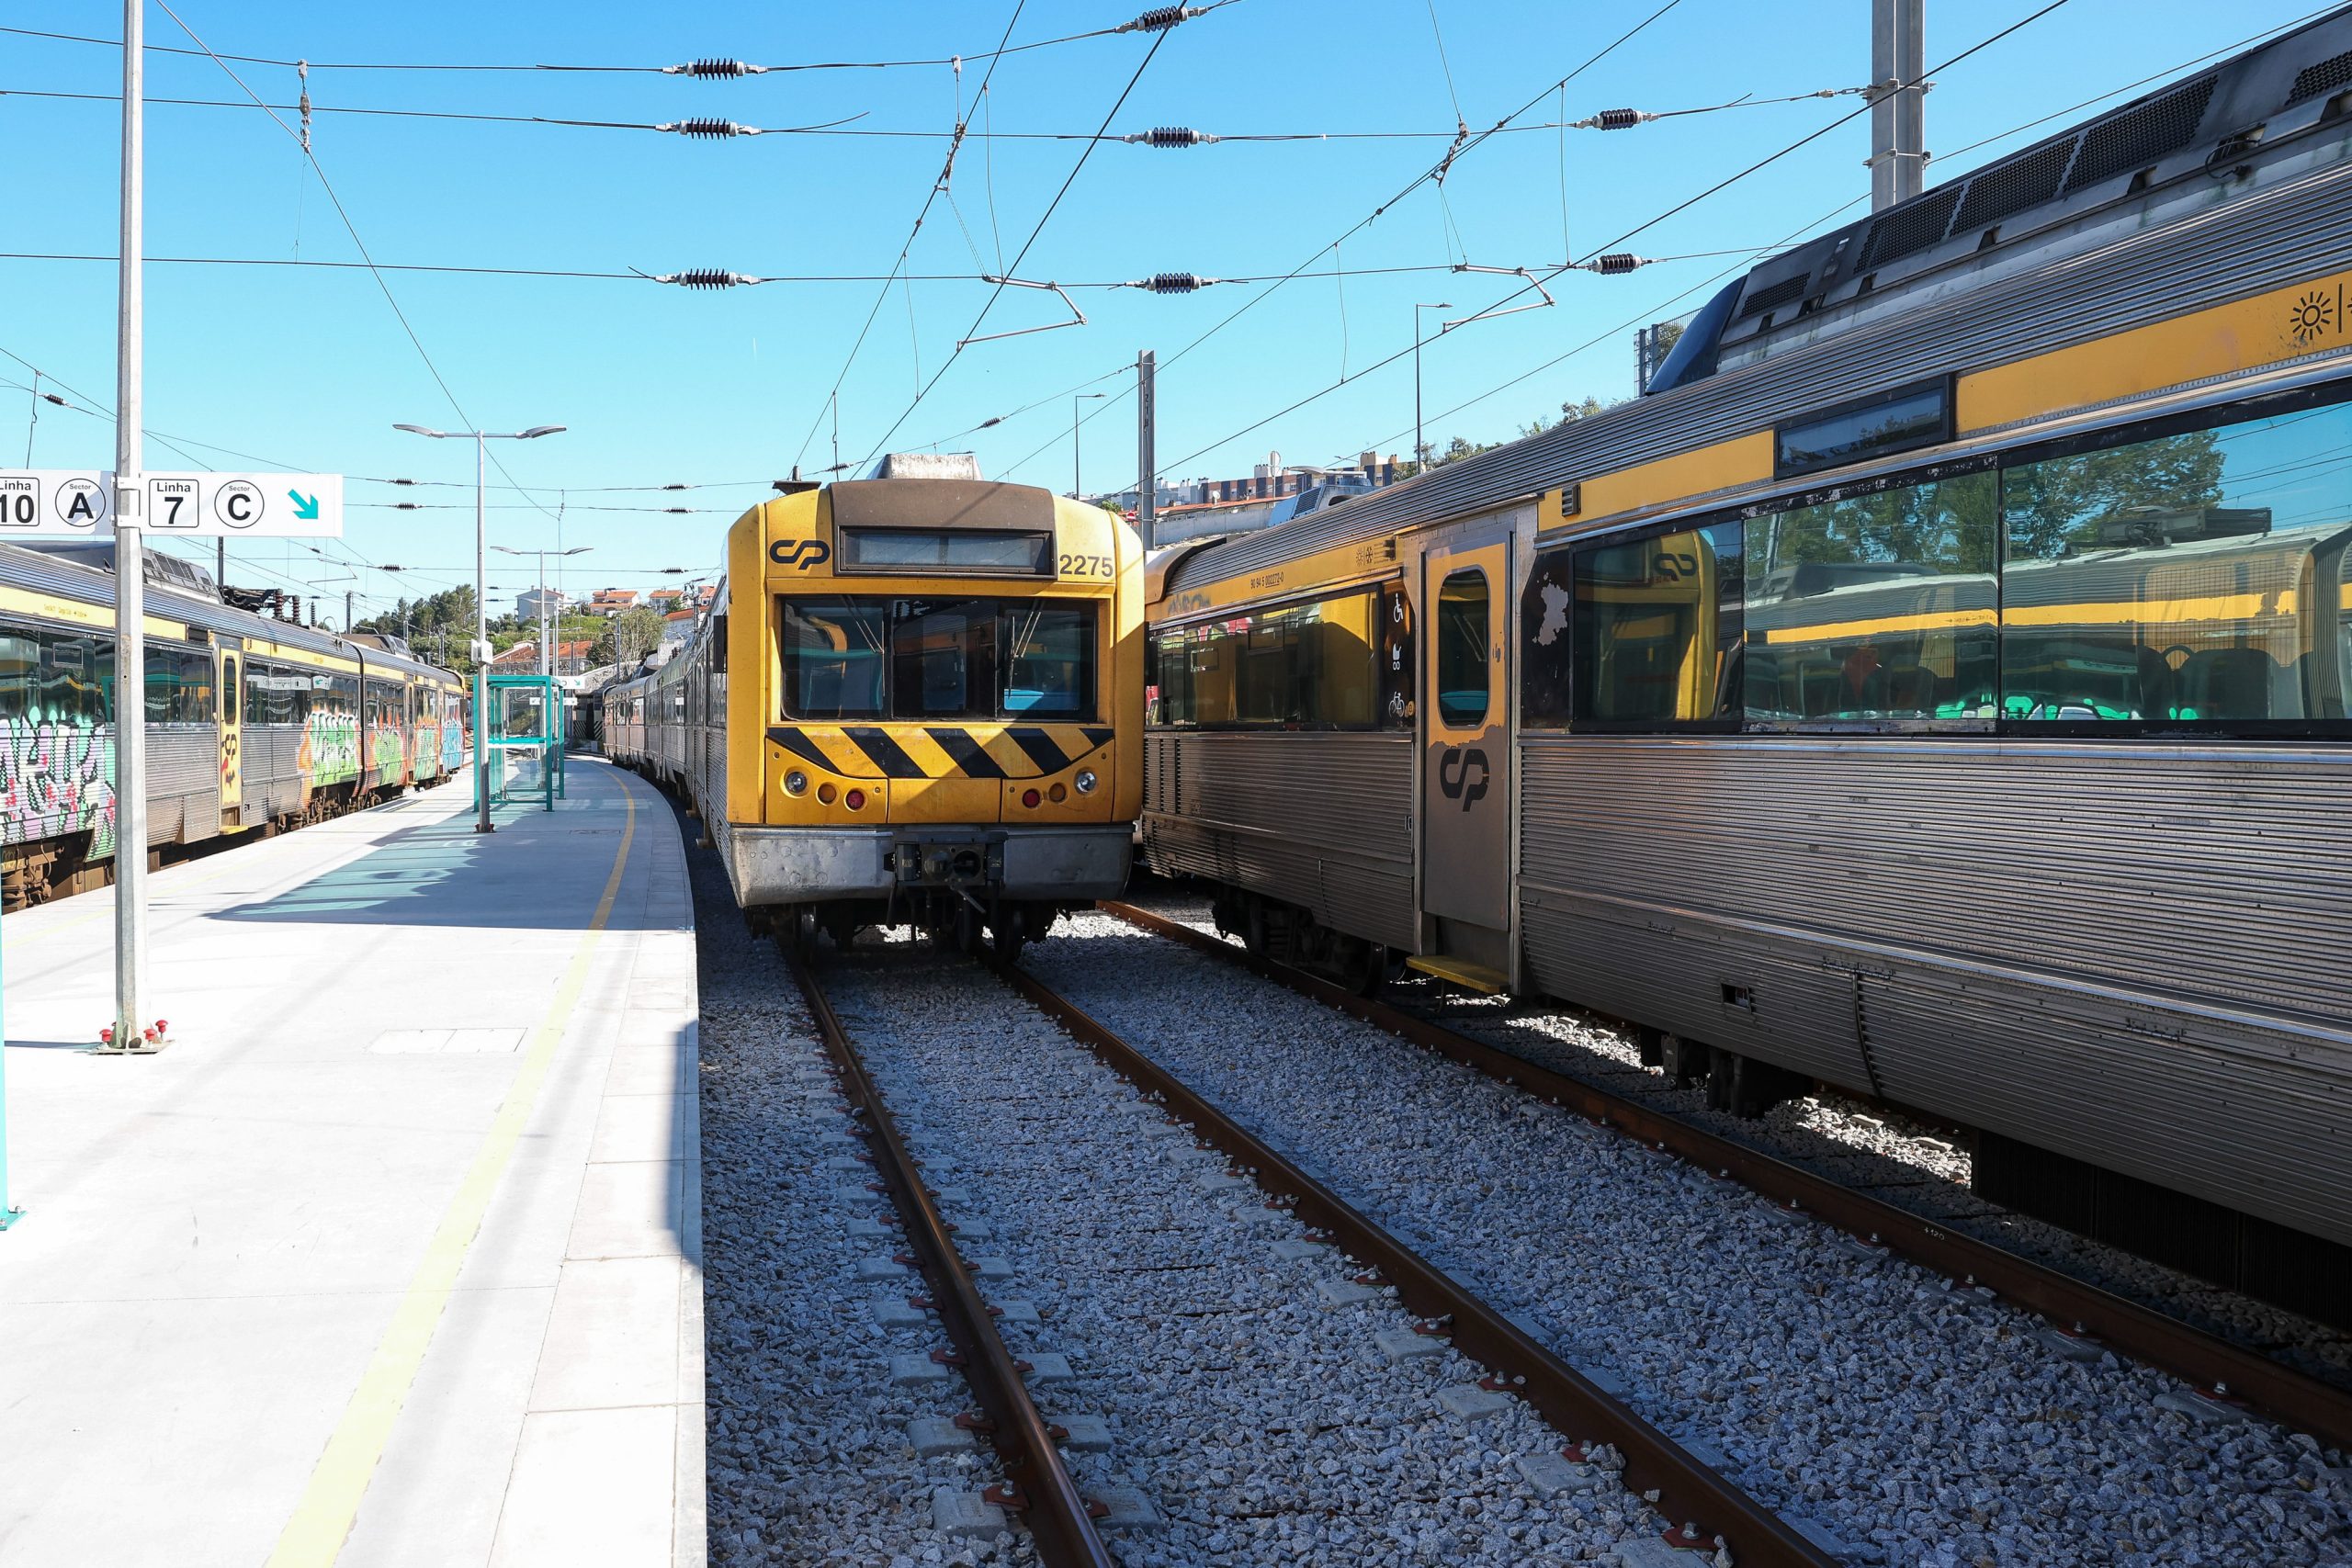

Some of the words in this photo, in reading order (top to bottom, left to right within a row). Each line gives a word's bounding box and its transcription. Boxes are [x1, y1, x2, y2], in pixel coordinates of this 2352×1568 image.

[156, 482, 191, 492] Linha
[0, 494, 35, 524] 10
[67, 491, 95, 519] A
[164, 496, 184, 525] 7
[227, 493, 252, 521] C
[1058, 554, 1114, 577] 2275
